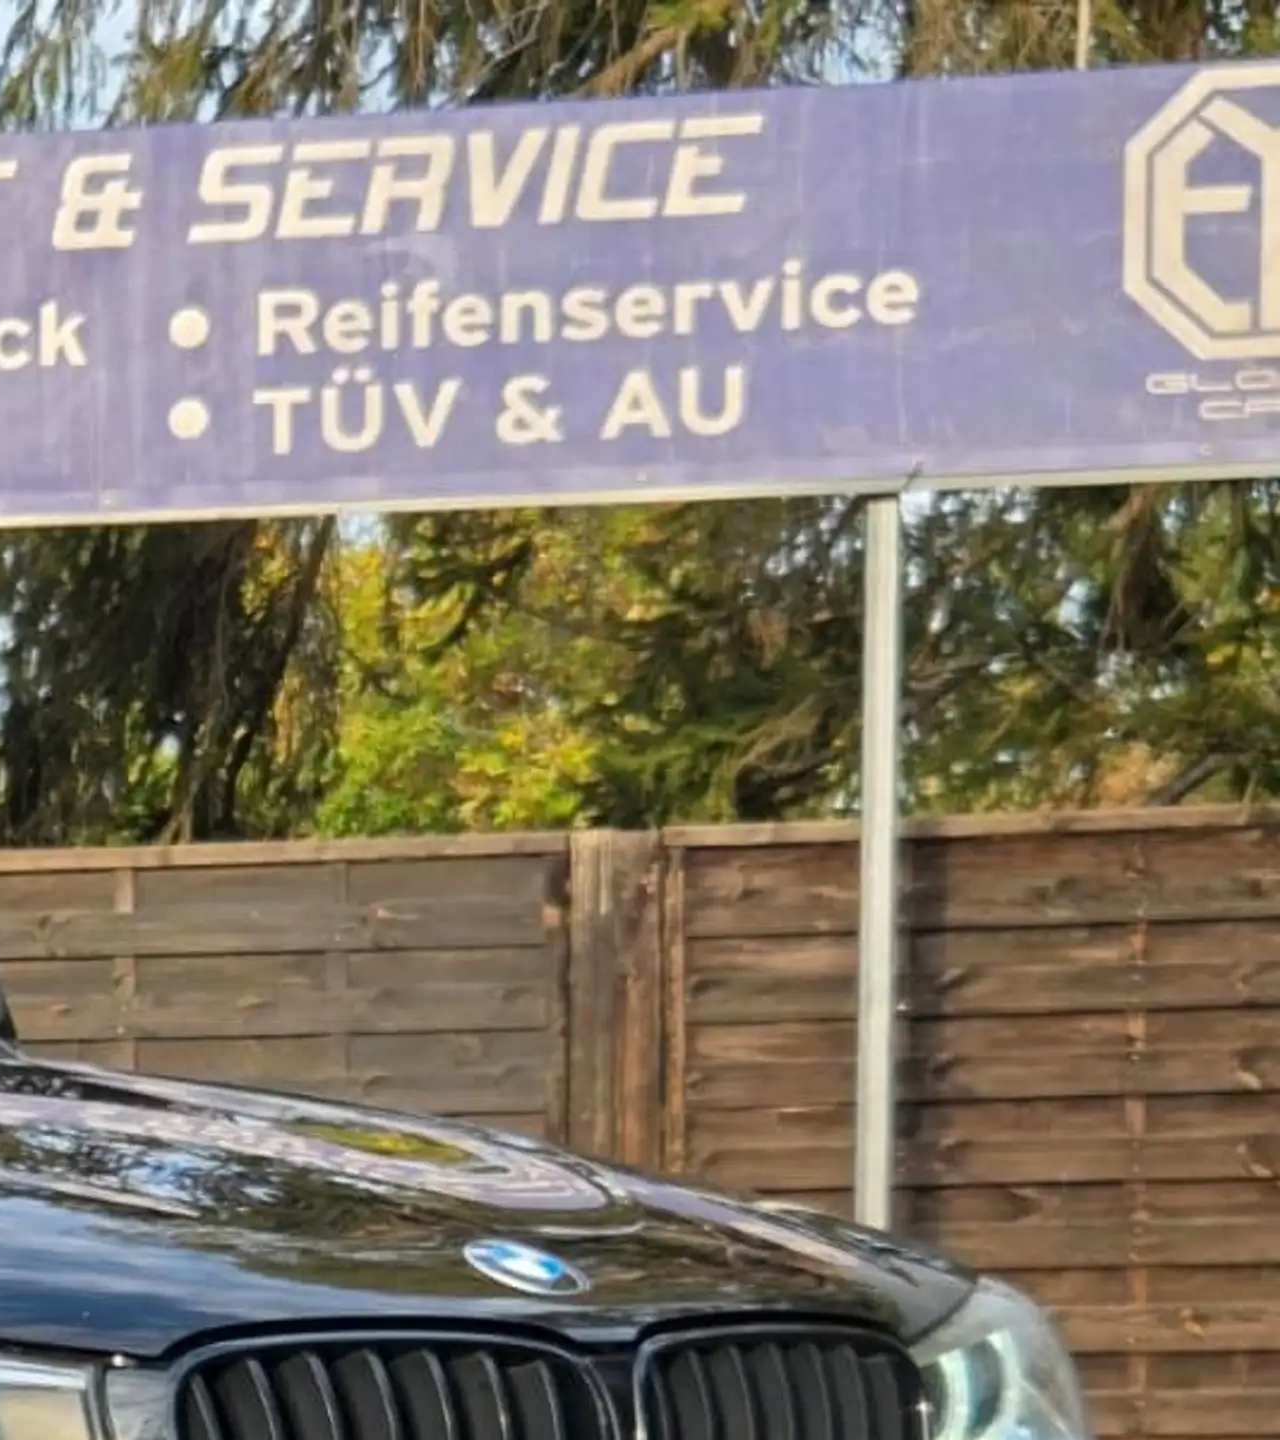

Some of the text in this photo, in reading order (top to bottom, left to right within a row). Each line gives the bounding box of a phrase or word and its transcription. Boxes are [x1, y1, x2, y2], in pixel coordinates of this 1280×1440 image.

[51, 153, 142, 251] &
[187, 114, 765, 244] SERVICE
[256, 258, 920, 357] Reifenservice
[252, 365, 749, 456] TÜV & AU
